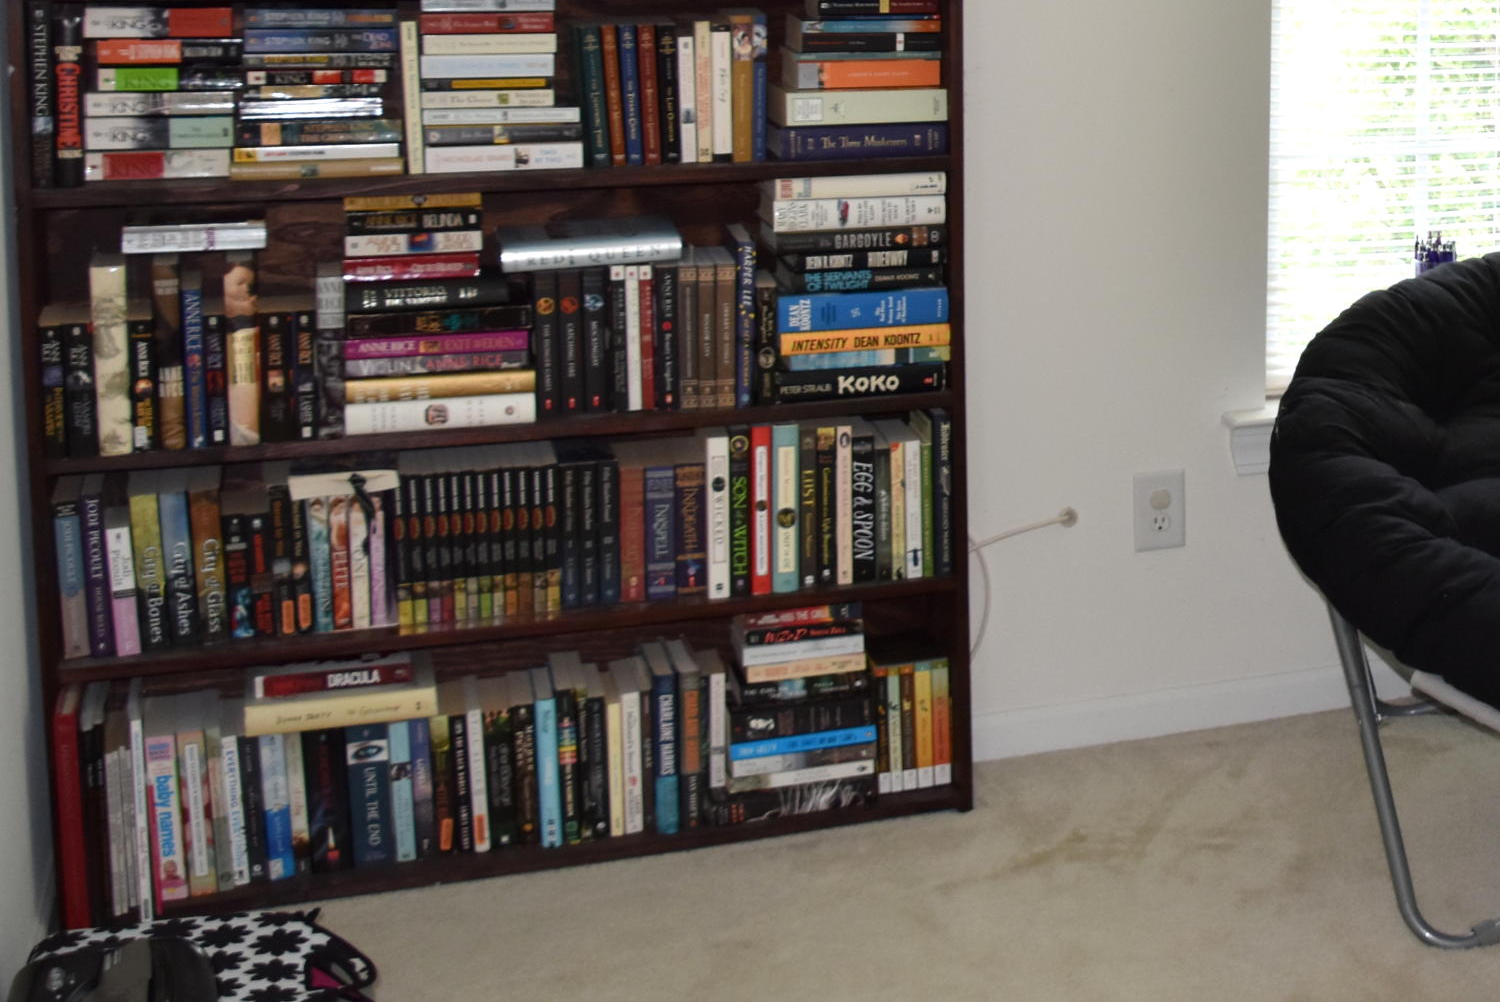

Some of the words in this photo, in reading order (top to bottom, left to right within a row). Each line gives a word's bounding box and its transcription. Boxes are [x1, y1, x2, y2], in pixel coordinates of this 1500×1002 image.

[32, 23, 49, 80] STEPHEN
[33, 83, 49, 117] KING
[55, 62, 82, 149] CHRISTINE
[588, 248, 661, 262] QUEEN
[834, 232, 892, 249] GARGOYLE
[742, 246, 754, 284] HARPER
[804, 273, 821, 282] THE
[823, 269, 872, 281] SERVANTS
[664, 273, 672, 296] ANNE
[741, 289, 753, 307] LEE
[807, 281, 821, 291] OF
[822, 279, 870, 290] TWILIGHT
[185, 293, 201, 327] ANNE
[664, 298, 672, 317] RICE
[799, 299, 811, 331] KOONTZ
[187, 328, 202, 351] RICE
[792, 337, 849, 352] INTENSITY
[854, 335, 880, 348] DEAN
[884, 332, 921, 345] KOONTZ
[472, 354, 503, 366] RICE
[663, 361, 673, 391] Kingdom
[837, 374, 900, 395] KOKO
[732, 476, 748, 509] SON
[801, 470, 817, 506] LOST
[852, 461, 875, 492] EGG
[584, 486, 593, 508] Shades
[604, 482, 612, 504] Shades
[853, 495, 874, 507] &
[84, 498, 100, 526] JODI
[715, 496, 725, 544] WICKED
[732, 524, 748, 576] WITCH
[852, 510, 875, 561] SPOON
[87, 530, 103, 578] PICOULT
[142, 546, 160, 579] City
[169, 541, 187, 575] City
[201, 538, 219, 573] City
[332, 550, 350, 589] ELITE
[149, 582, 163, 594] of
[174, 577, 190, 589] of
[204, 576, 219, 588] of
[147, 596, 165, 643] Bones
[176, 592, 194, 637] Ashes
[207, 589, 225, 633] Glass
[326, 669, 381, 689] DRACULA
[658, 693, 675, 742] CHARLAINE
[154, 775, 173, 807] baby
[363, 766, 378, 798] UNTIL
[225, 750, 239, 808] EVERYTHING
[232, 811, 247, 868] EVERYTHING
[366, 800, 379, 821] THE
[160, 811, 176, 856] names
[368, 823, 381, 846] END
